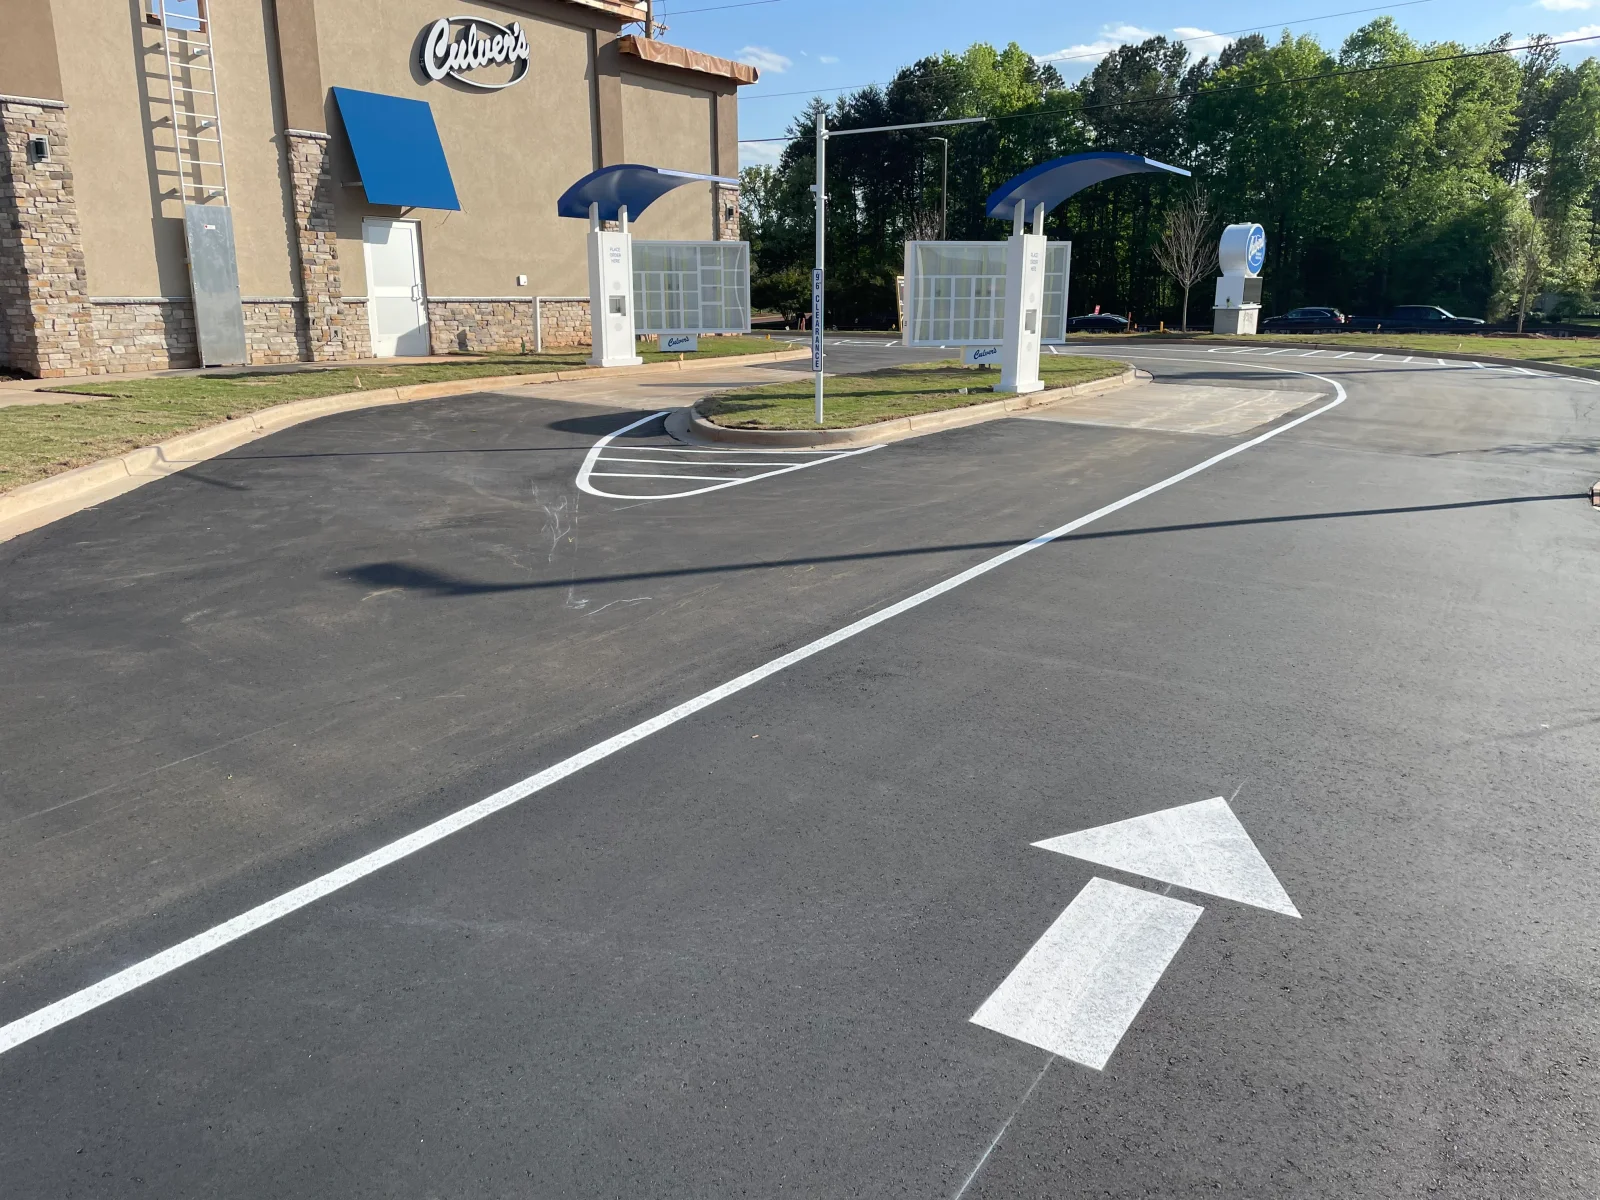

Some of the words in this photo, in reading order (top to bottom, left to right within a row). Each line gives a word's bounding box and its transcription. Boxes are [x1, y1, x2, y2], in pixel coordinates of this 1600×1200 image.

[424, 18, 530, 80] Culver's
[668, 336, 690, 347] Culver's
[974, 347, 997, 360] Culver's
